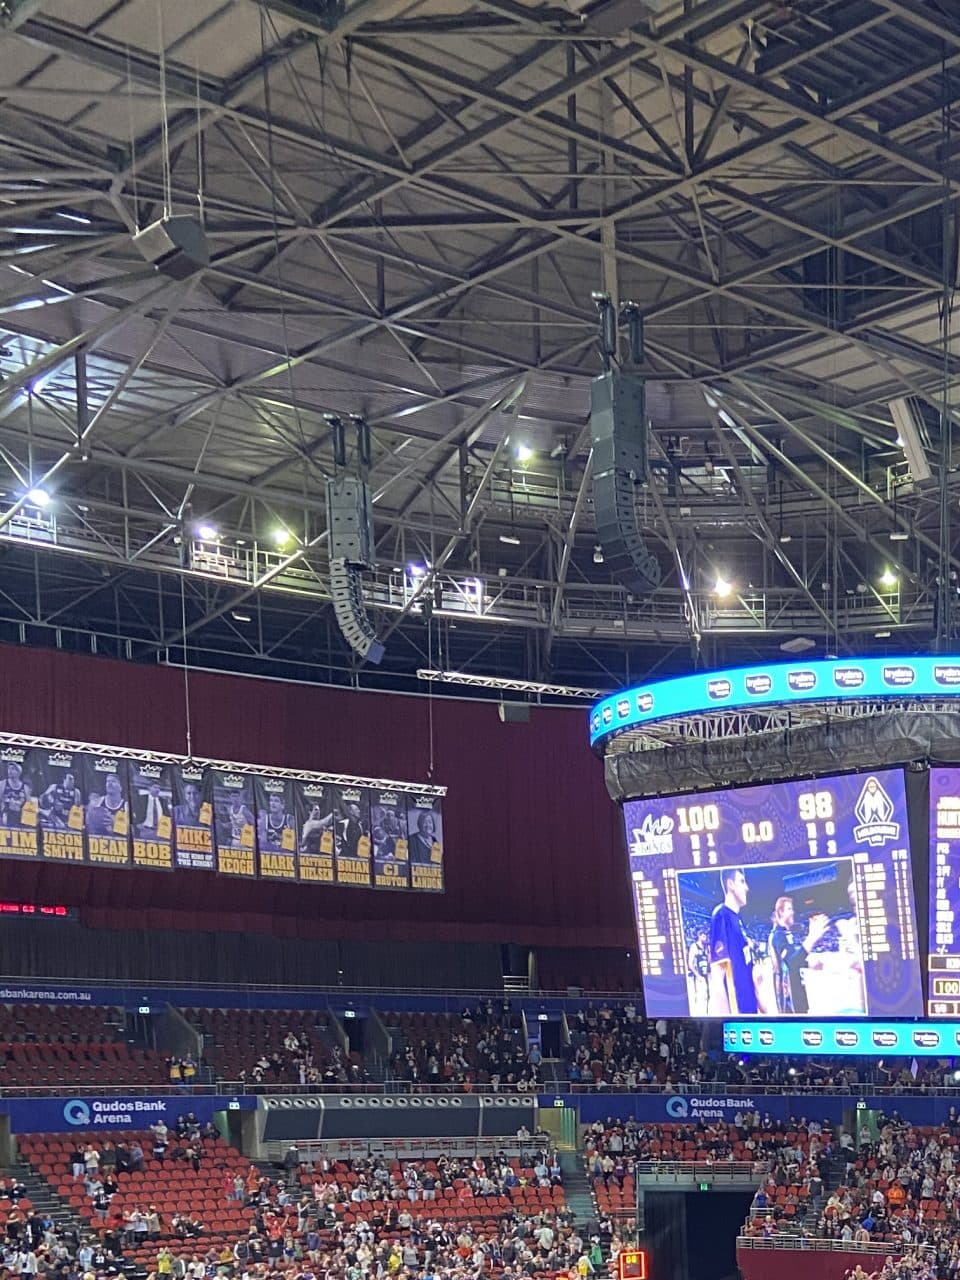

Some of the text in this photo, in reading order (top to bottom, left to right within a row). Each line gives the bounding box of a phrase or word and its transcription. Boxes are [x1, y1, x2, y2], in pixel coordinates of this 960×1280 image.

[799, 792, 832, 820] 98
[677, 805, 719, 832] 100
[0, 830, 37, 849] TIM
[43, 831, 83, 849] JASON
[177, 828, 212, 845] MIKE
[742, 821, 773, 842] 0.0
[44, 845, 84, 861] SMITH
[88, 838, 129, 857] DEAN
[134, 841, 172, 861] BOB
[219, 857, 254, 875] KEOGH
[261, 854, 295, 871] MARK
[338, 859, 370, 873] BRIAN
[383, 864, 399, 876] CJ
[0, 989, 91, 1000] sbankarena.com.au
[938, 982, 958, 993] 100
[93, 1101, 166, 1112] Qudos Bank
[690, 1098, 754, 1109] Qudos Bank
[93, 1113, 131, 1123] Arena
[691, 1109, 723, 1118] Arena
